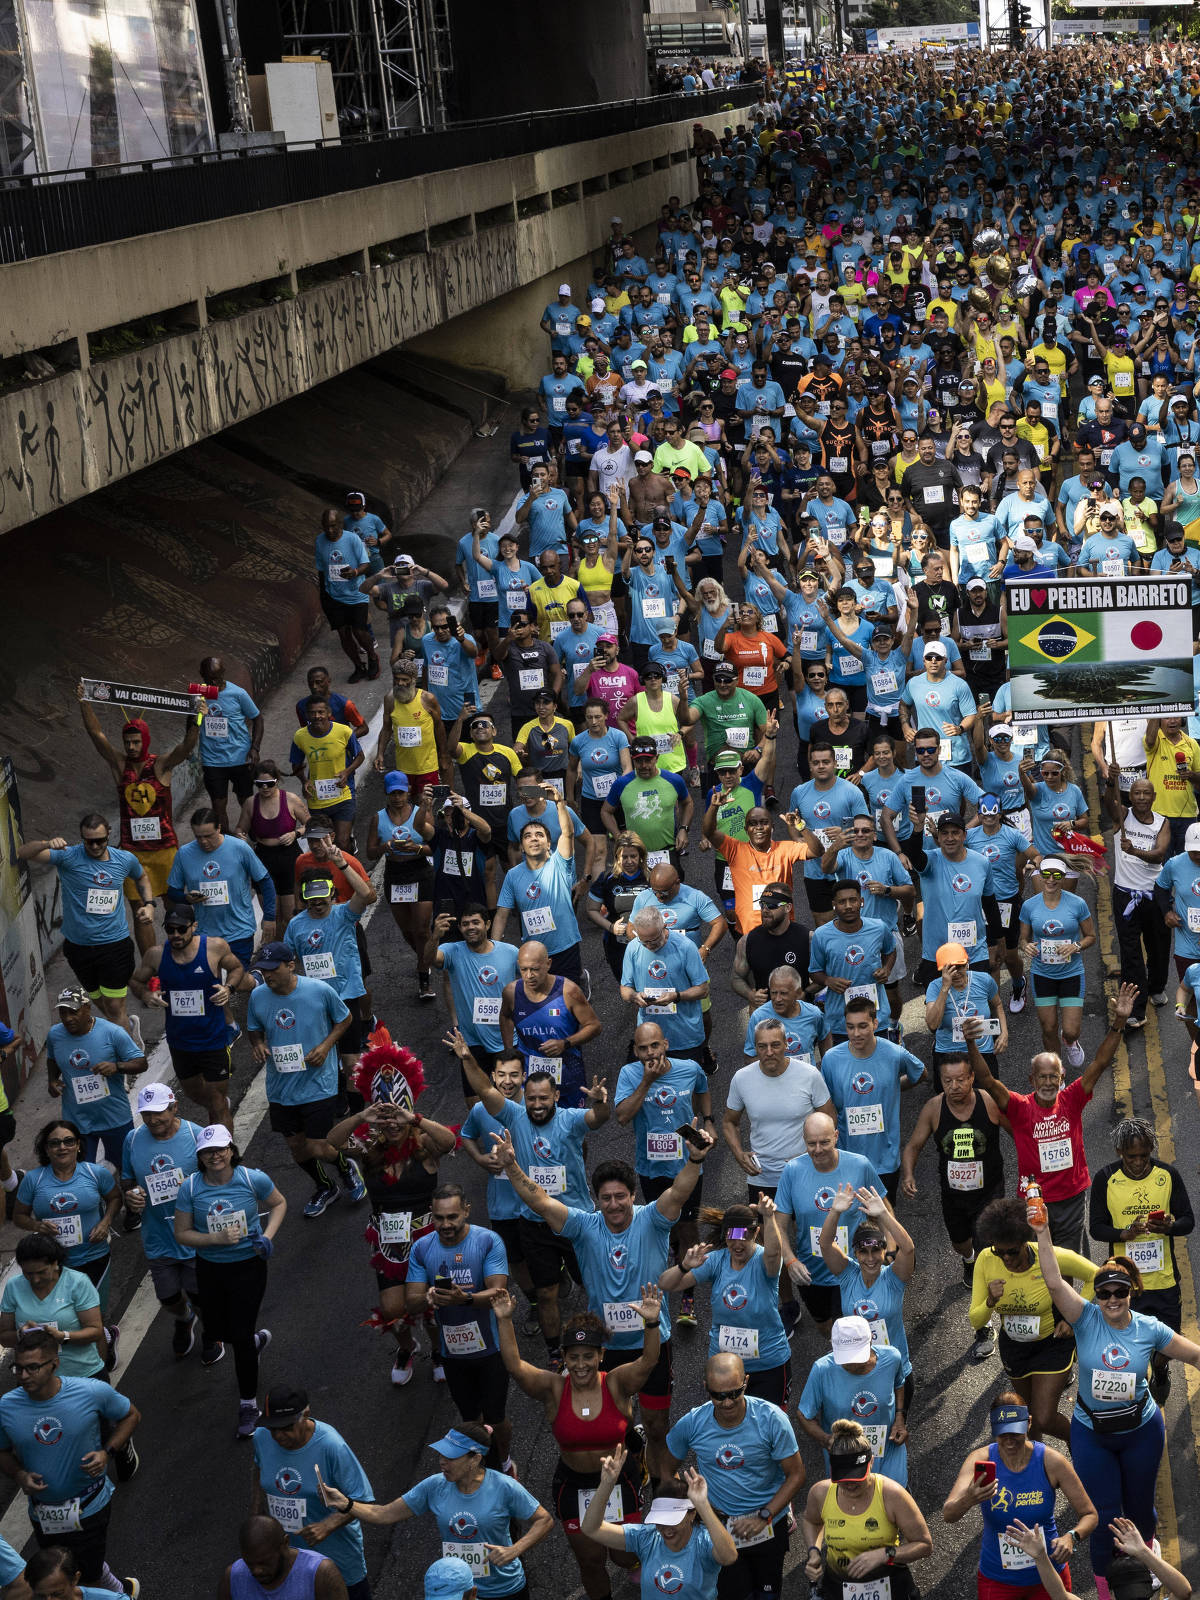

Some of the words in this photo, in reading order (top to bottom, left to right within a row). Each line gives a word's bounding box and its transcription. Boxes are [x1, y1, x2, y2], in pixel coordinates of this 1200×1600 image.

[1010, 588, 1030, 612] EU
[1048, 585, 1114, 610] PEREIRA
[1116, 582, 1188, 607] BARRETO
[115, 688, 130, 700] VAI
[131, 691, 190, 708] CORINTHIANS!
[527, 914, 546, 926] 8131
[952, 928, 971, 939] 7098
[306, 960, 330, 972] 25040
[174, 996, 196, 1007] 7671
[522, 1023, 558, 1036] ITÁLIA
[274, 1052, 299, 1064] 22489
[77, 1081, 99, 1094] 5166
[849, 1112, 877, 1126] 20575
[1034, 1120, 1055, 1131] NOVO
[1033, 1122, 1070, 1139] AMANHECER
[652, 1140, 674, 1150] 1805
[956, 1149, 970, 1157] UM
[1042, 1148, 1071, 1161] 15768
[534, 1174, 558, 1185] 5852
[950, 1170, 978, 1180] 39227
[150, 1178, 179, 1194] 15540
[1128, 1250, 1158, 1262] 15694
[450, 1268, 472, 1278] VIVA
[607, 1308, 638, 1322] 11087
[1006, 1322, 1035, 1336] 21584
[446, 1330, 476, 1344] 38792
[723, 1334, 750, 1349] 7174
[1094, 1380, 1128, 1394] 27220
[1016, 1490, 1043, 1500] corrida
[1016, 1498, 1044, 1508] perfeita
[38, 1508, 70, 1523] 24337
[269, 1506, 300, 1521] 16080
